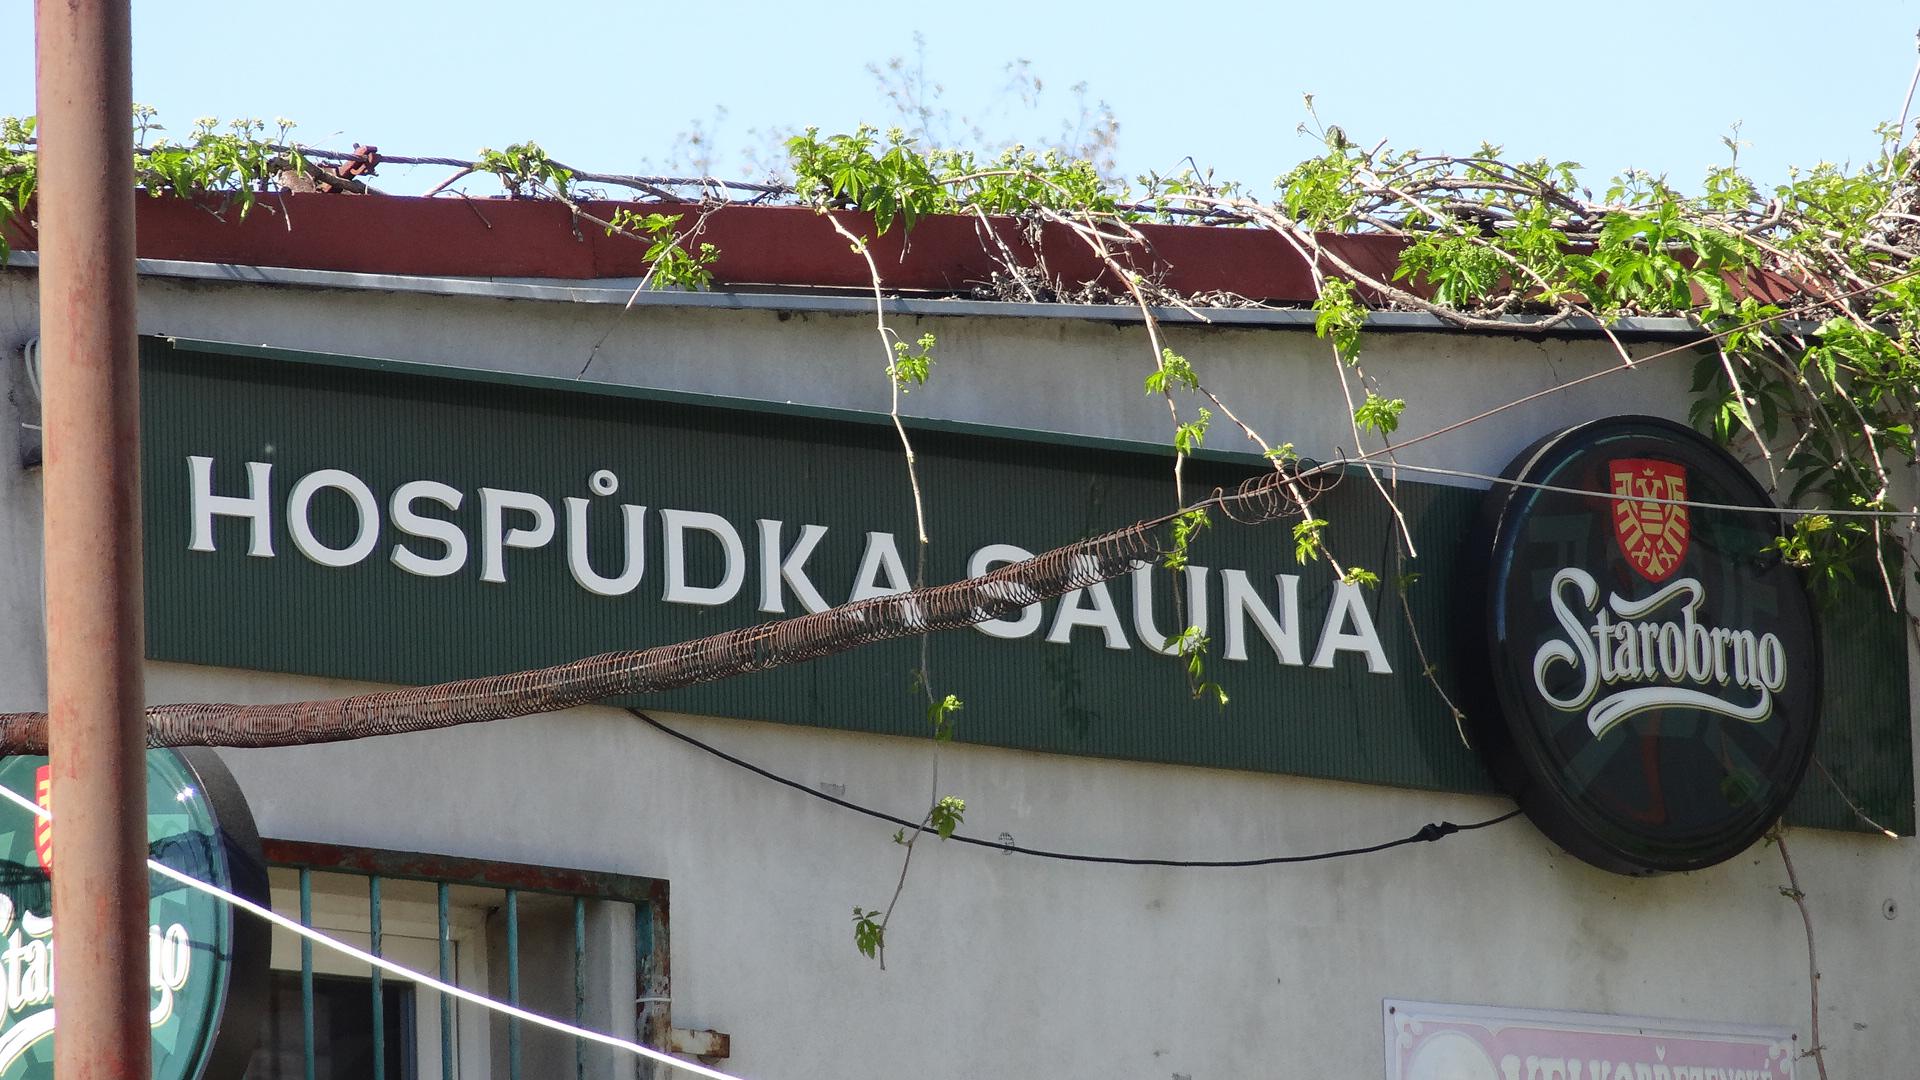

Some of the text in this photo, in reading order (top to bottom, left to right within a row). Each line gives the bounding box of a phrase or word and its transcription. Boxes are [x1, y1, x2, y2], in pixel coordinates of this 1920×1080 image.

[186, 455, 1393, 674] HOSPŮDKA SAUNA
[1533, 567, 1788, 741] Starobrno
